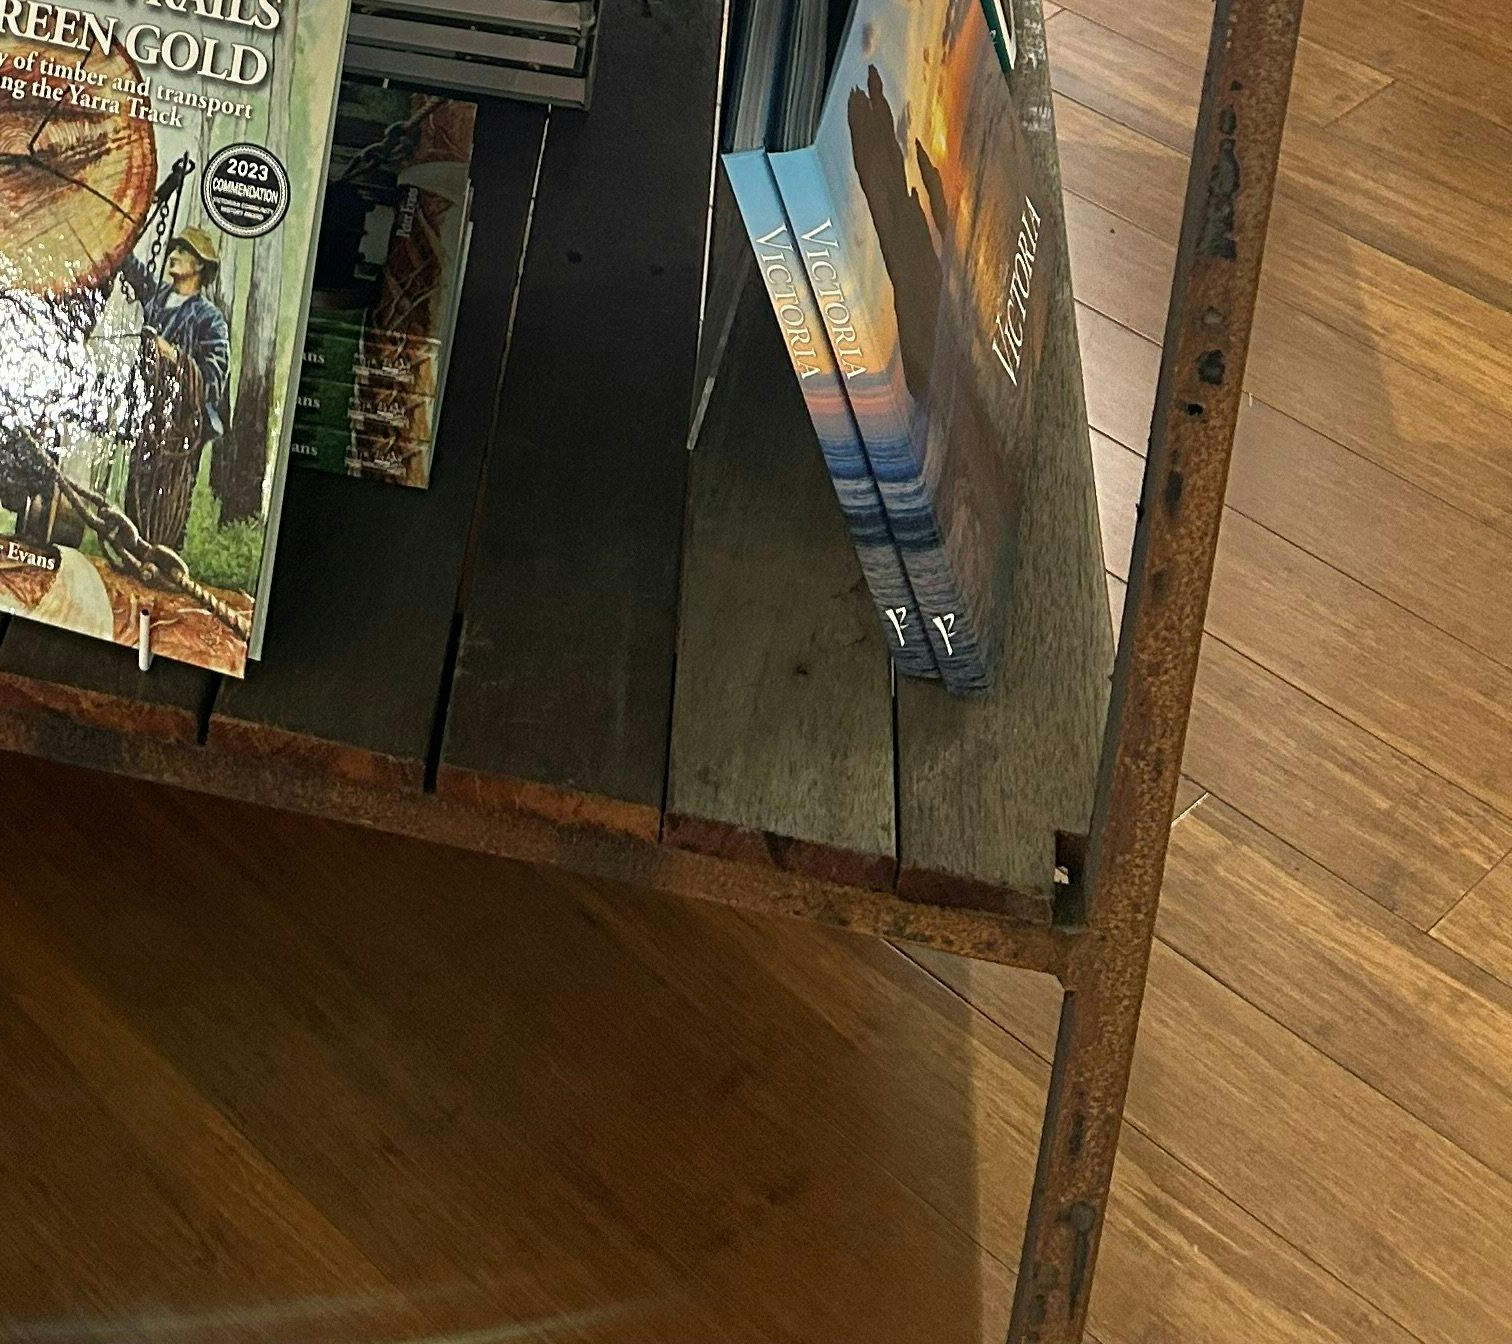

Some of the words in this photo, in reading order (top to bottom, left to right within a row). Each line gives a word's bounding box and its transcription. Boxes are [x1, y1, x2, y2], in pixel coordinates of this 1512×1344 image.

[125, 23, 269, 86] GOLD
[14, 53, 37, 72] of
[39, 58, 108, 90] timber
[111, 72, 151, 98] and
[155, 86, 254, 121] transport
[31, 80, 64, 101] the
[67, 84, 121, 115] Yarra
[127, 97, 185, 129] Track
[212, 177, 279, 204] COMMENDATION
[227, 158, 269, 181] 2023
[755, 221, 821, 380] VICTORIA
[800, 217, 868, 379] VICTORIA
[7, 541, 57, 571] Evans
